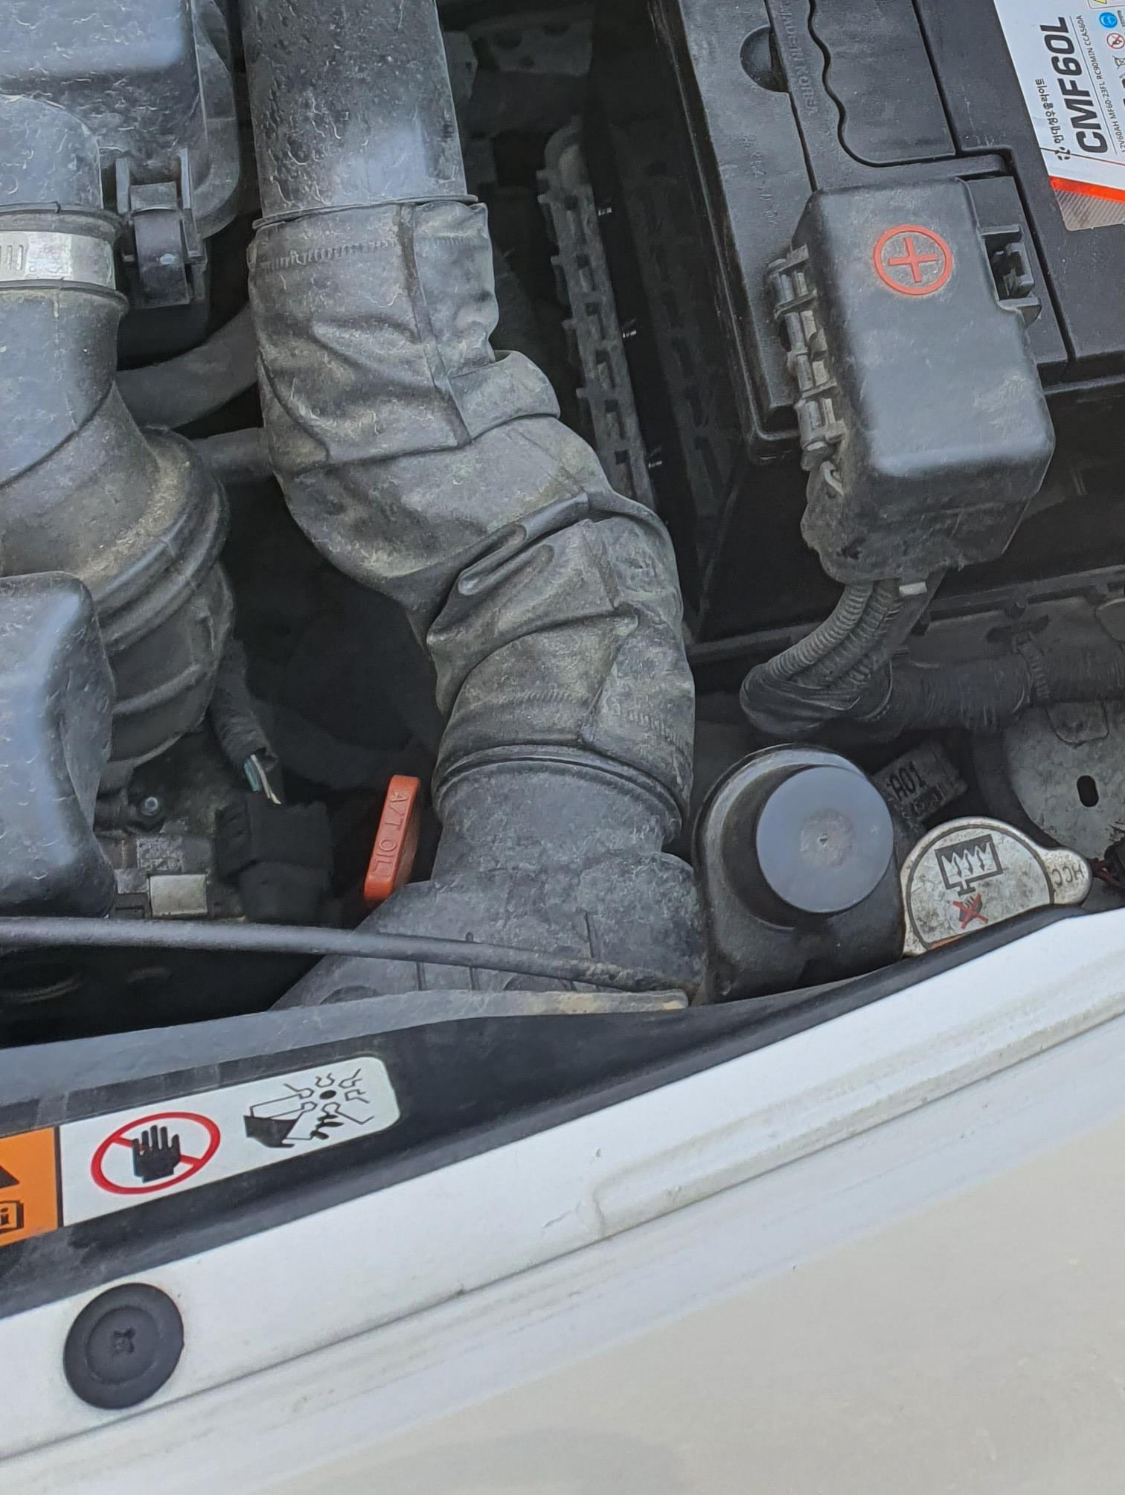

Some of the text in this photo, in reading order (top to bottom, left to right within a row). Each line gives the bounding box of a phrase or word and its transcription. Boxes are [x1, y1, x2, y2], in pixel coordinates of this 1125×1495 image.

[1085, 47, 1104, 80] RC90MIN
[1046, 16, 1108, 153] CMF60L
[1097, 81, 1117, 119] MF60-23FL
[1033, 77, 1065, 144] 현대성우쏠라이트
[372, 839, 397, 875] OIL
